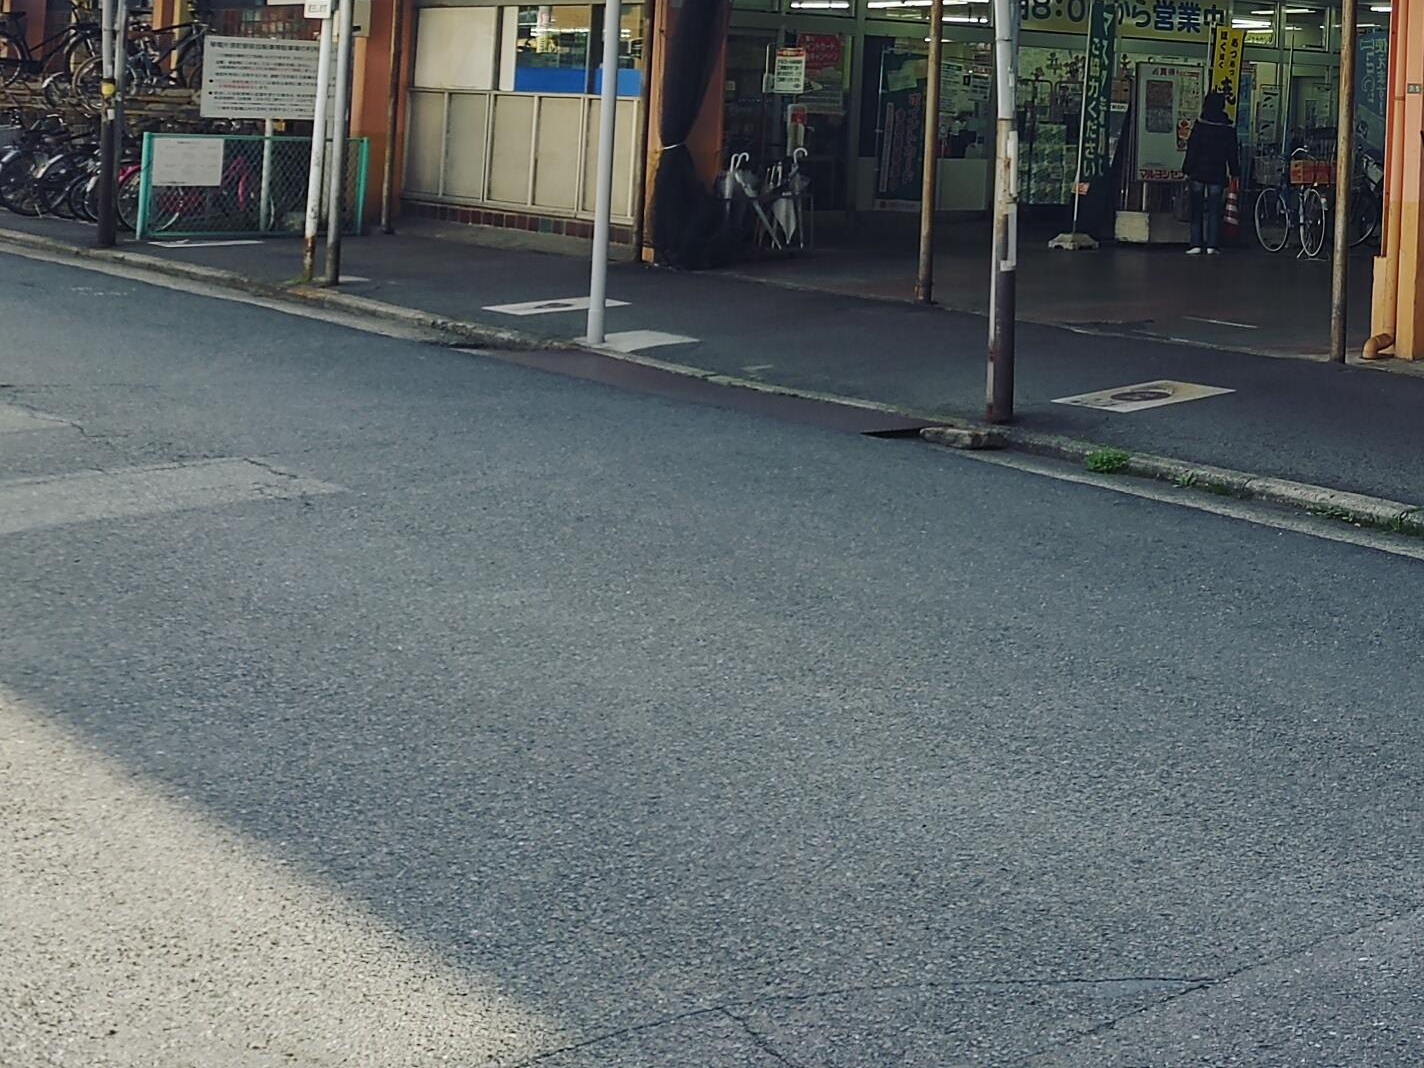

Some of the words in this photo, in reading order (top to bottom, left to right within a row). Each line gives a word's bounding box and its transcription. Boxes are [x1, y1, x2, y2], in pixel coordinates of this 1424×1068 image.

[1140, 169, 1187, 181] マルヨシセン
